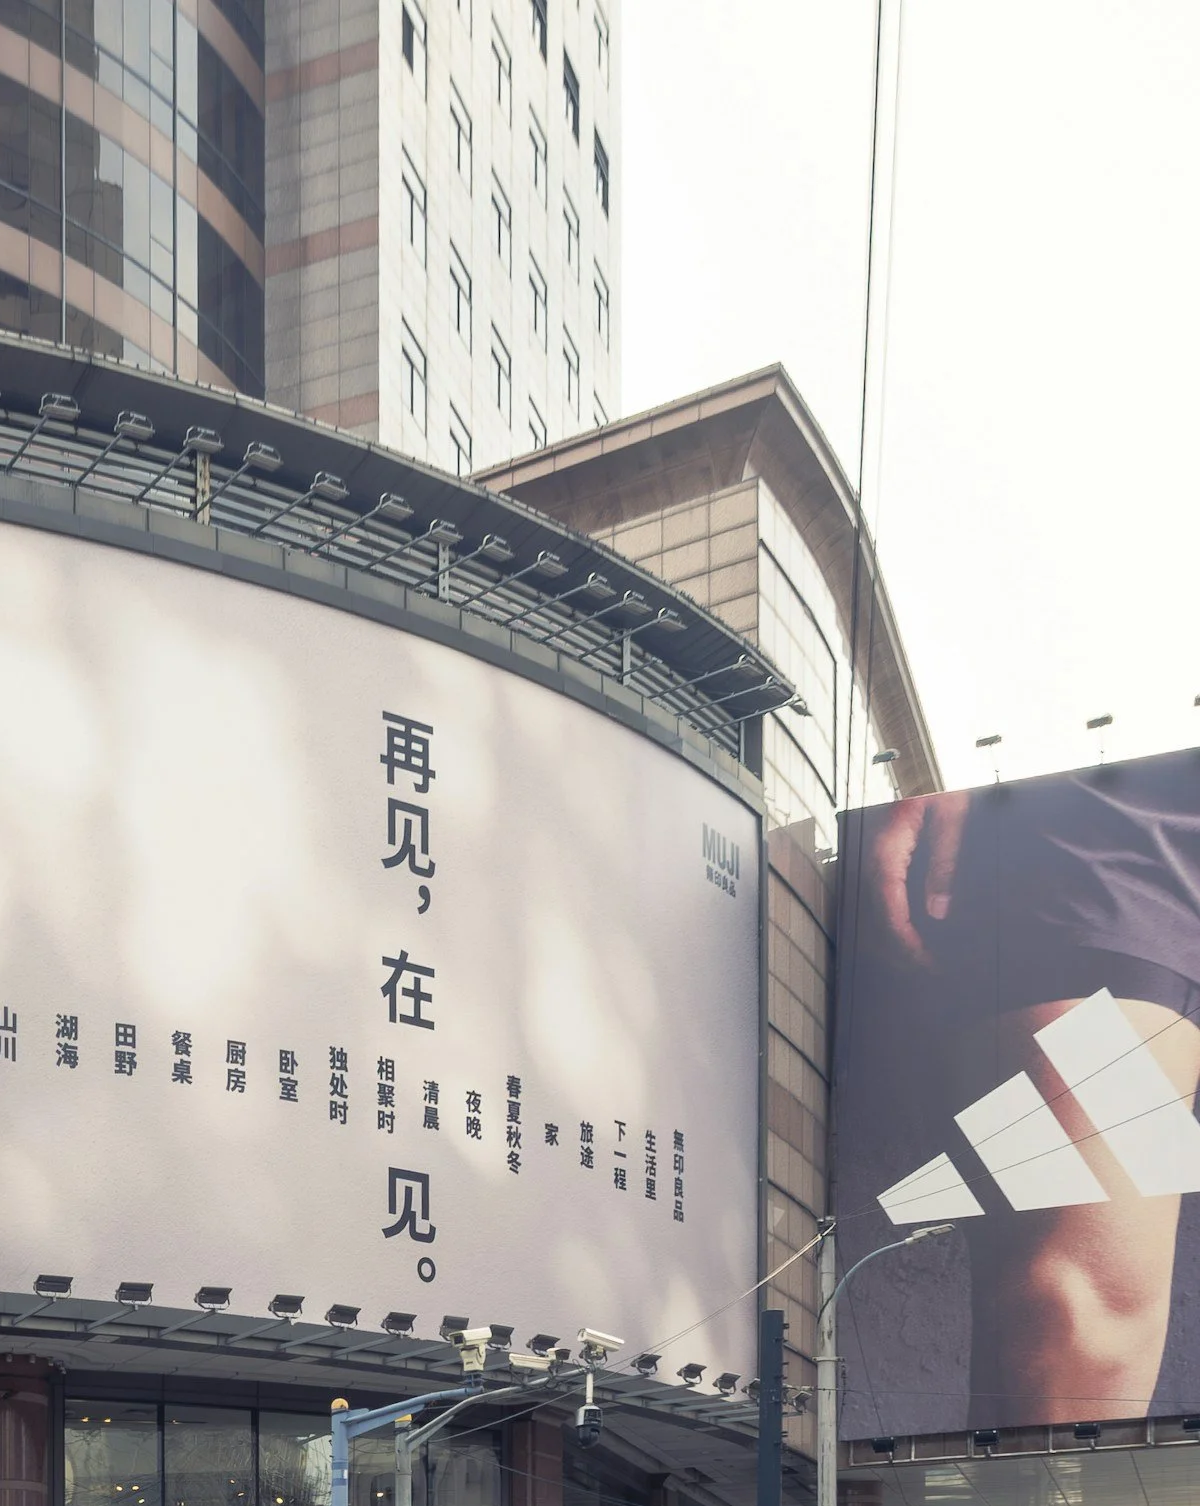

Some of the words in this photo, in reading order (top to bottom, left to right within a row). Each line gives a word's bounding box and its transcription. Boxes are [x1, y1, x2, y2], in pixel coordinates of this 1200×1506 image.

[702, 822, 740, 881] MUJI
[55, 1013, 79, 1070] 湖海
[114, 1023, 138, 1077] 田野
[171, 1029, 193, 1085] 餐桌
[225, 1039, 247, 1094] 厨房
[278, 1048, 299, 1103] 卧室
[328, 1045, 349, 1125] 独处时
[376, 1055, 396, 1135] 相聚时
[422, 1079, 440, 1132] 清晨
[465, 1089, 483, 1141] 夜晚
[506, 1075, 522, 1175] 春夏秋冬
[544, 1122, 560, 1147] 家
[579, 1120, 595, 1170] 旅途
[613, 1119, 627, 1192] 下一程
[644, 1129, 657, 1201] 生活里
